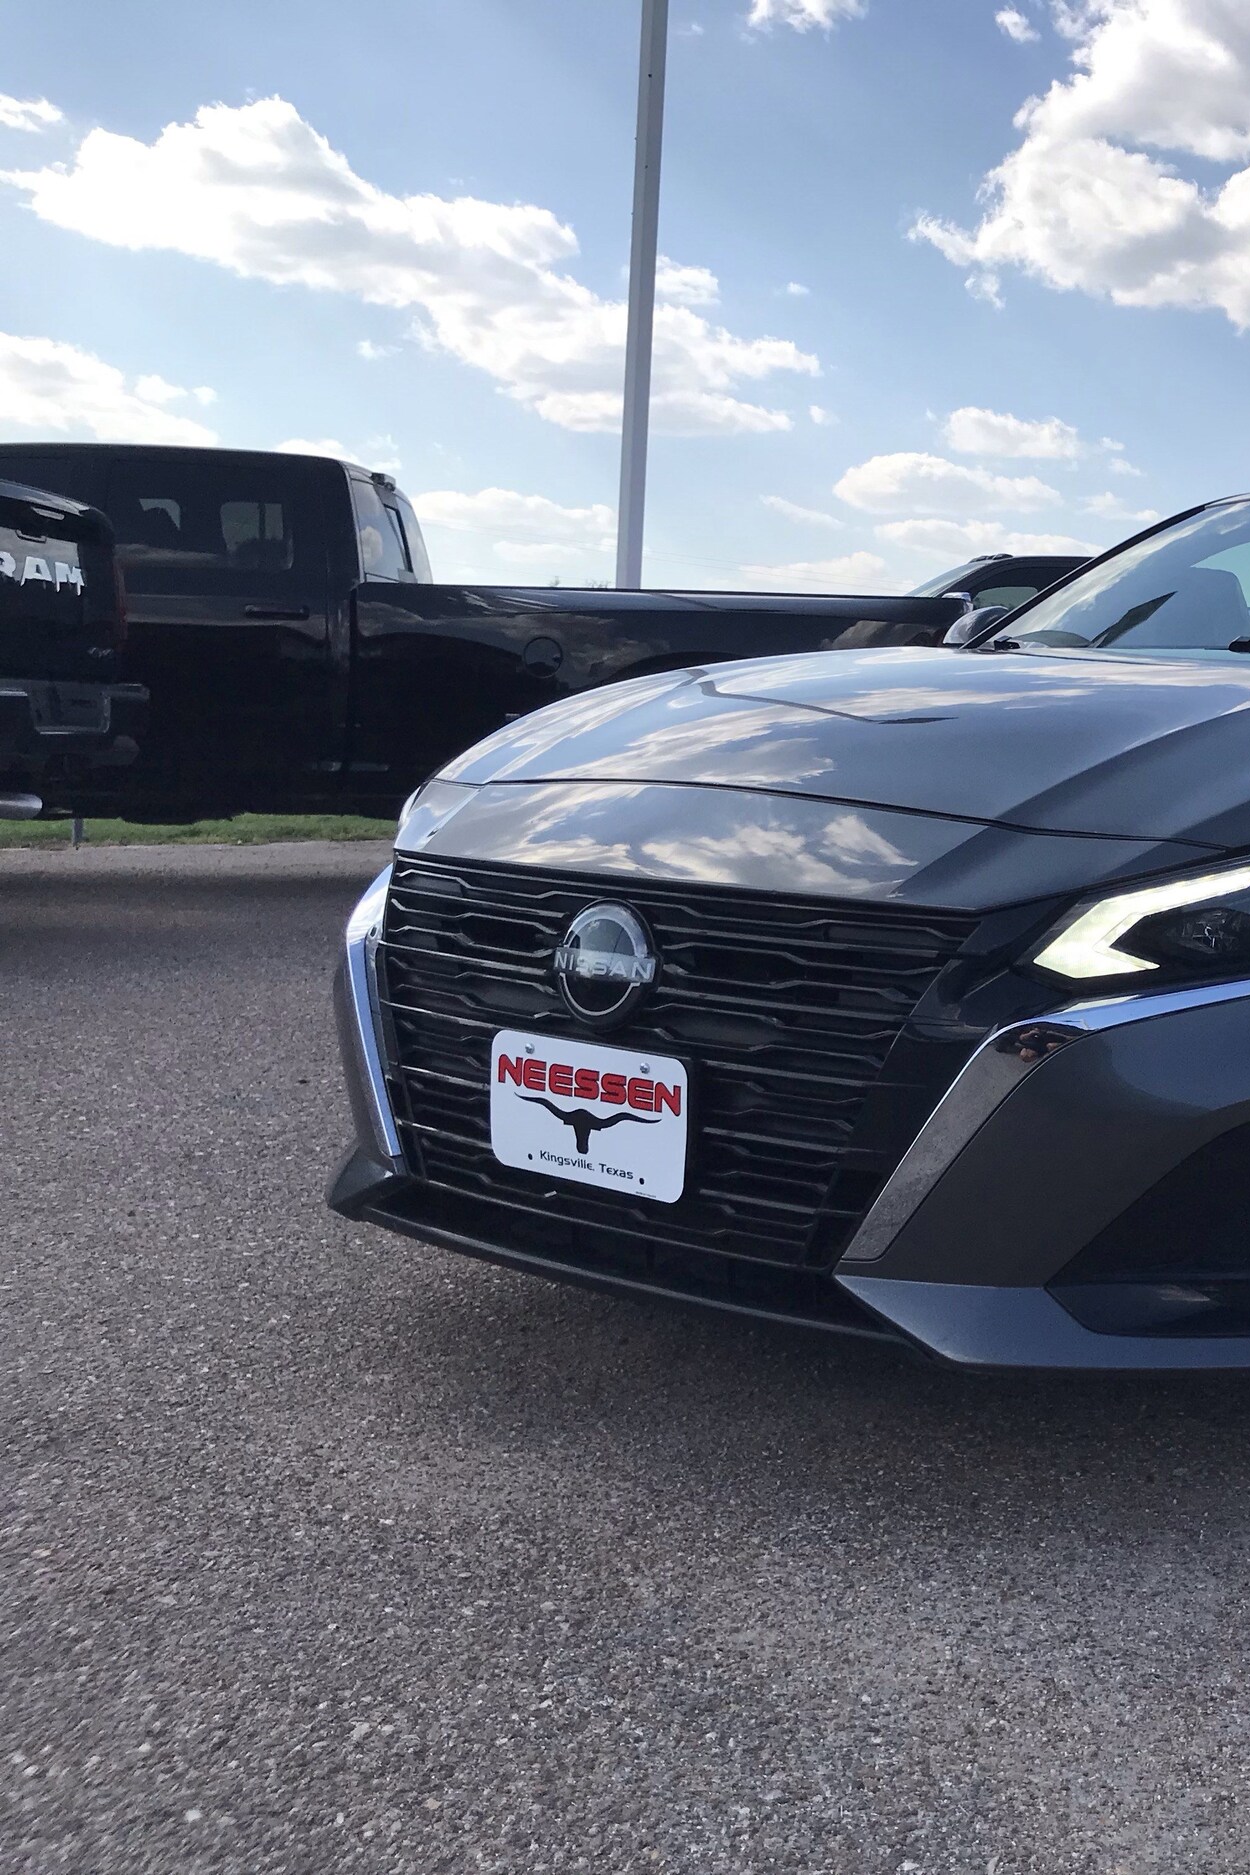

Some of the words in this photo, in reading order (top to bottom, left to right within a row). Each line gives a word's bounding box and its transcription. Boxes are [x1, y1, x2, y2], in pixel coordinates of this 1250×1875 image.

[554, 951, 652, 980] NISSAN
[498, 1053, 682, 1117] NEESSEN
[598, 1163, 635, 1180] Texas
